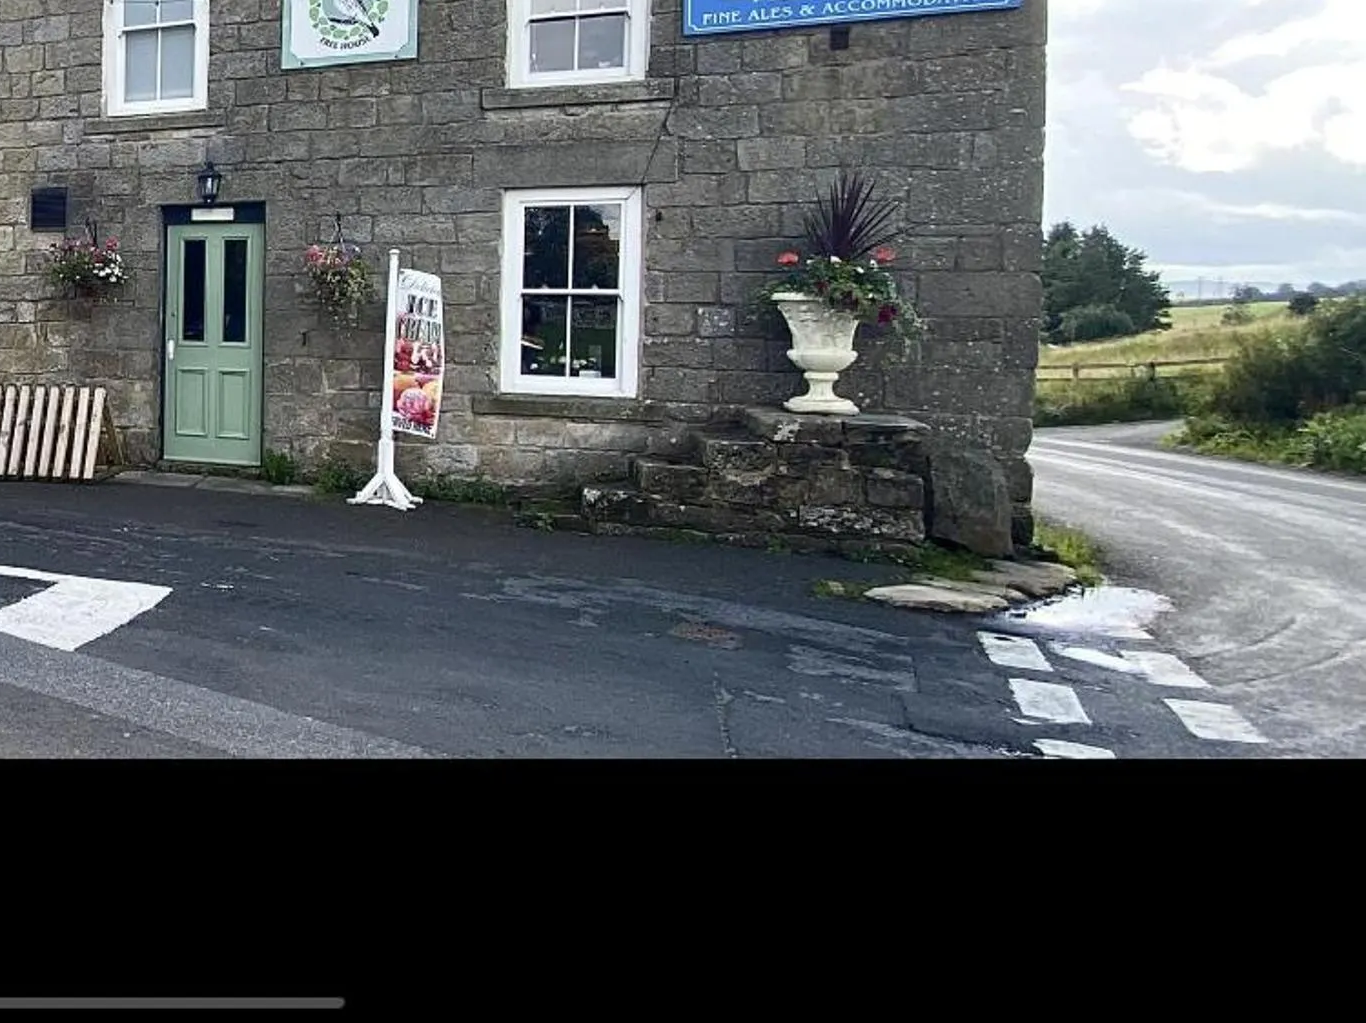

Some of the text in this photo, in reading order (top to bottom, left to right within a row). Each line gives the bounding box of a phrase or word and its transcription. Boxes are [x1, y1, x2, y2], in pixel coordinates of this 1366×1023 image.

[702, 11, 742, 26] FINE
[748, 5, 793, 21] ALES
[799, 4, 815, 17] &
